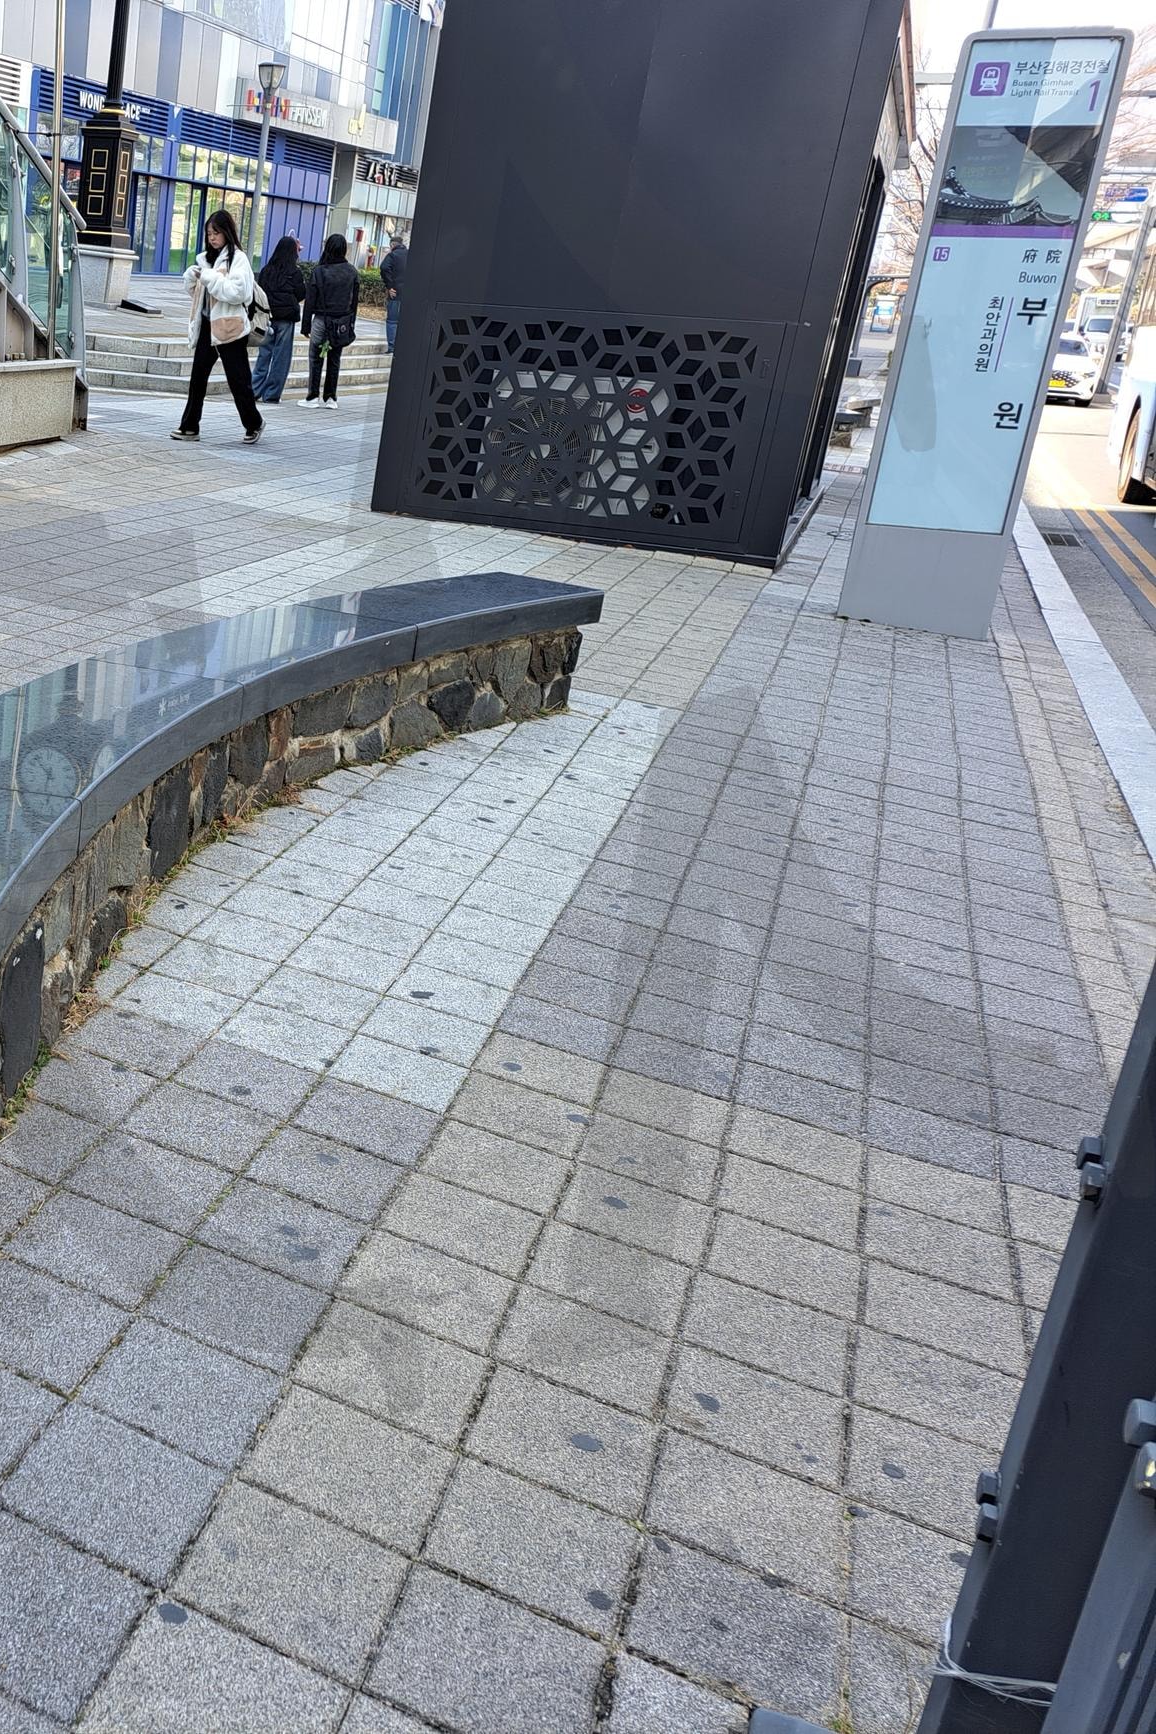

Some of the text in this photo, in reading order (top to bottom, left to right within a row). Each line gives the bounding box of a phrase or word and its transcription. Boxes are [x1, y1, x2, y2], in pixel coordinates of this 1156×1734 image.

[1015, 59, 1112, 75] 부산김해경전철
[1012, 78, 1074, 87] Busan Gimhae
[1050, 89, 1079, 97] Transit
[1088, 79, 1101, 112] 1
[934, 248, 949, 261] 15
[1018, 271, 1057, 284] Buwon
[974, 296, 1005, 373] 최안과의원
